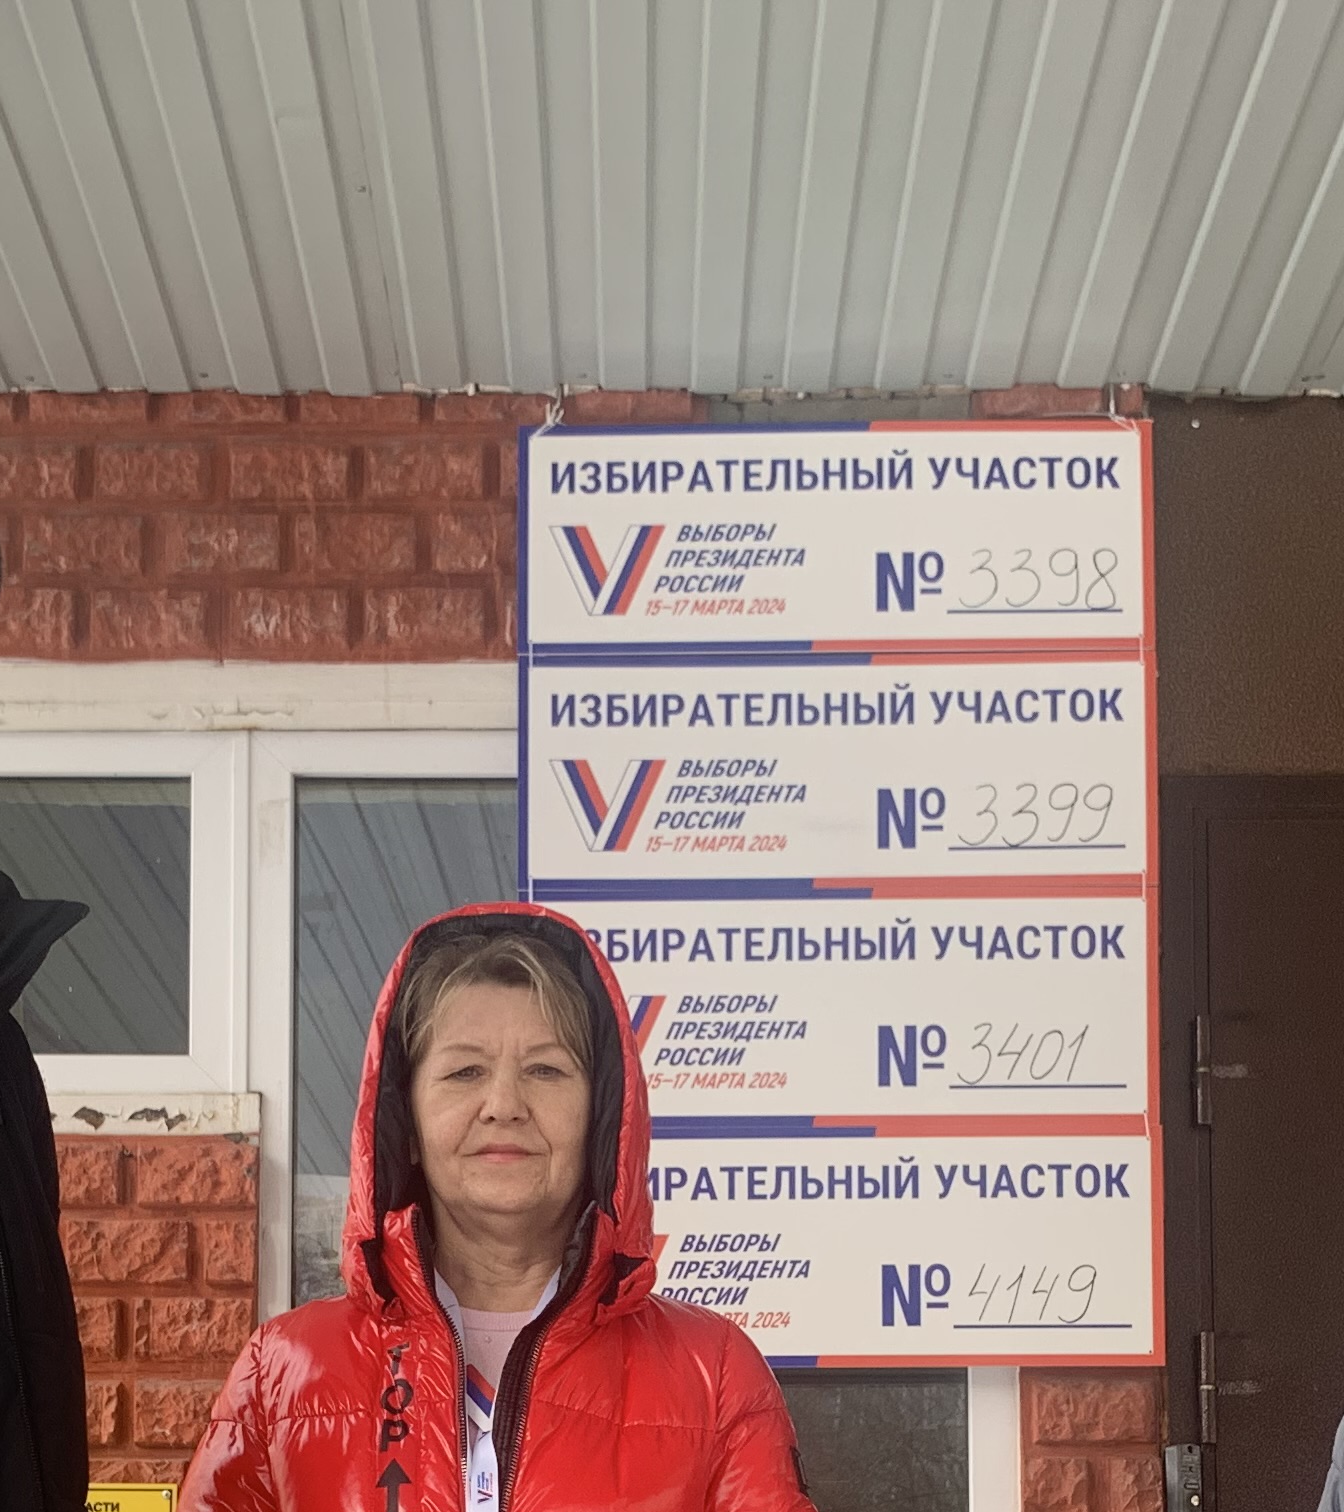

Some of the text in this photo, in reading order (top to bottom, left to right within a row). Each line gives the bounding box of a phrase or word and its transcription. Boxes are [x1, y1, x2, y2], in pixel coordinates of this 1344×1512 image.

[550, 450, 1120, 495] ИЗБИРАТЕЛЬНЫЙ УЧАСТОК
[677, 523, 777, 542] ВЫБОРЫ
[665, 549, 805, 569] ПРЕЗИДЕНТА
[654, 575, 744, 593] РОССИИ
[958, 548, 1118, 609] 3398
[691, 599, 745, 616] МАРТА
[748, 598, 787, 615] 2024
[550, 683, 1124, 728] ИЗБИРАТЕЛЬНЫЙ УЧАСТОК
[677, 759, 777, 778] ВЫБОРЫ
[665, 785, 806, 805] ПРЕЗИДЕНТА
[654, 811, 745, 830] РОССИИ
[958, 783, 1114, 847] 3399
[691, 836, 746, 852] МАРТА
[749, 835, 788, 851] 2024
[585, 918, 1126, 964] БИРАТЕЛЬНЫЙ УЧАСТОК
[678, 994, 778, 1015] ВЫБОРЫ
[665, 1020, 808, 1041] ПРЕЗИДЕНТА
[654, 1048, 745, 1067] РОССИИ
[957, 1022, 1089, 1085] 3401
[692, 1073, 747, 1089] МАРТА
[750, 1072, 789, 1089] 2024
[645, 1156, 1130, 1202] ИРАТЕЛЬНЫЙ УЧАСТОК
[680, 1233, 781, 1253] ВЫБОРЫ
[668, 1260, 811, 1281] ПРЕЗИДЕНТА
[968, 1262, 1098, 1325] 4149
[751, 1311, 792, 1329] 2024
